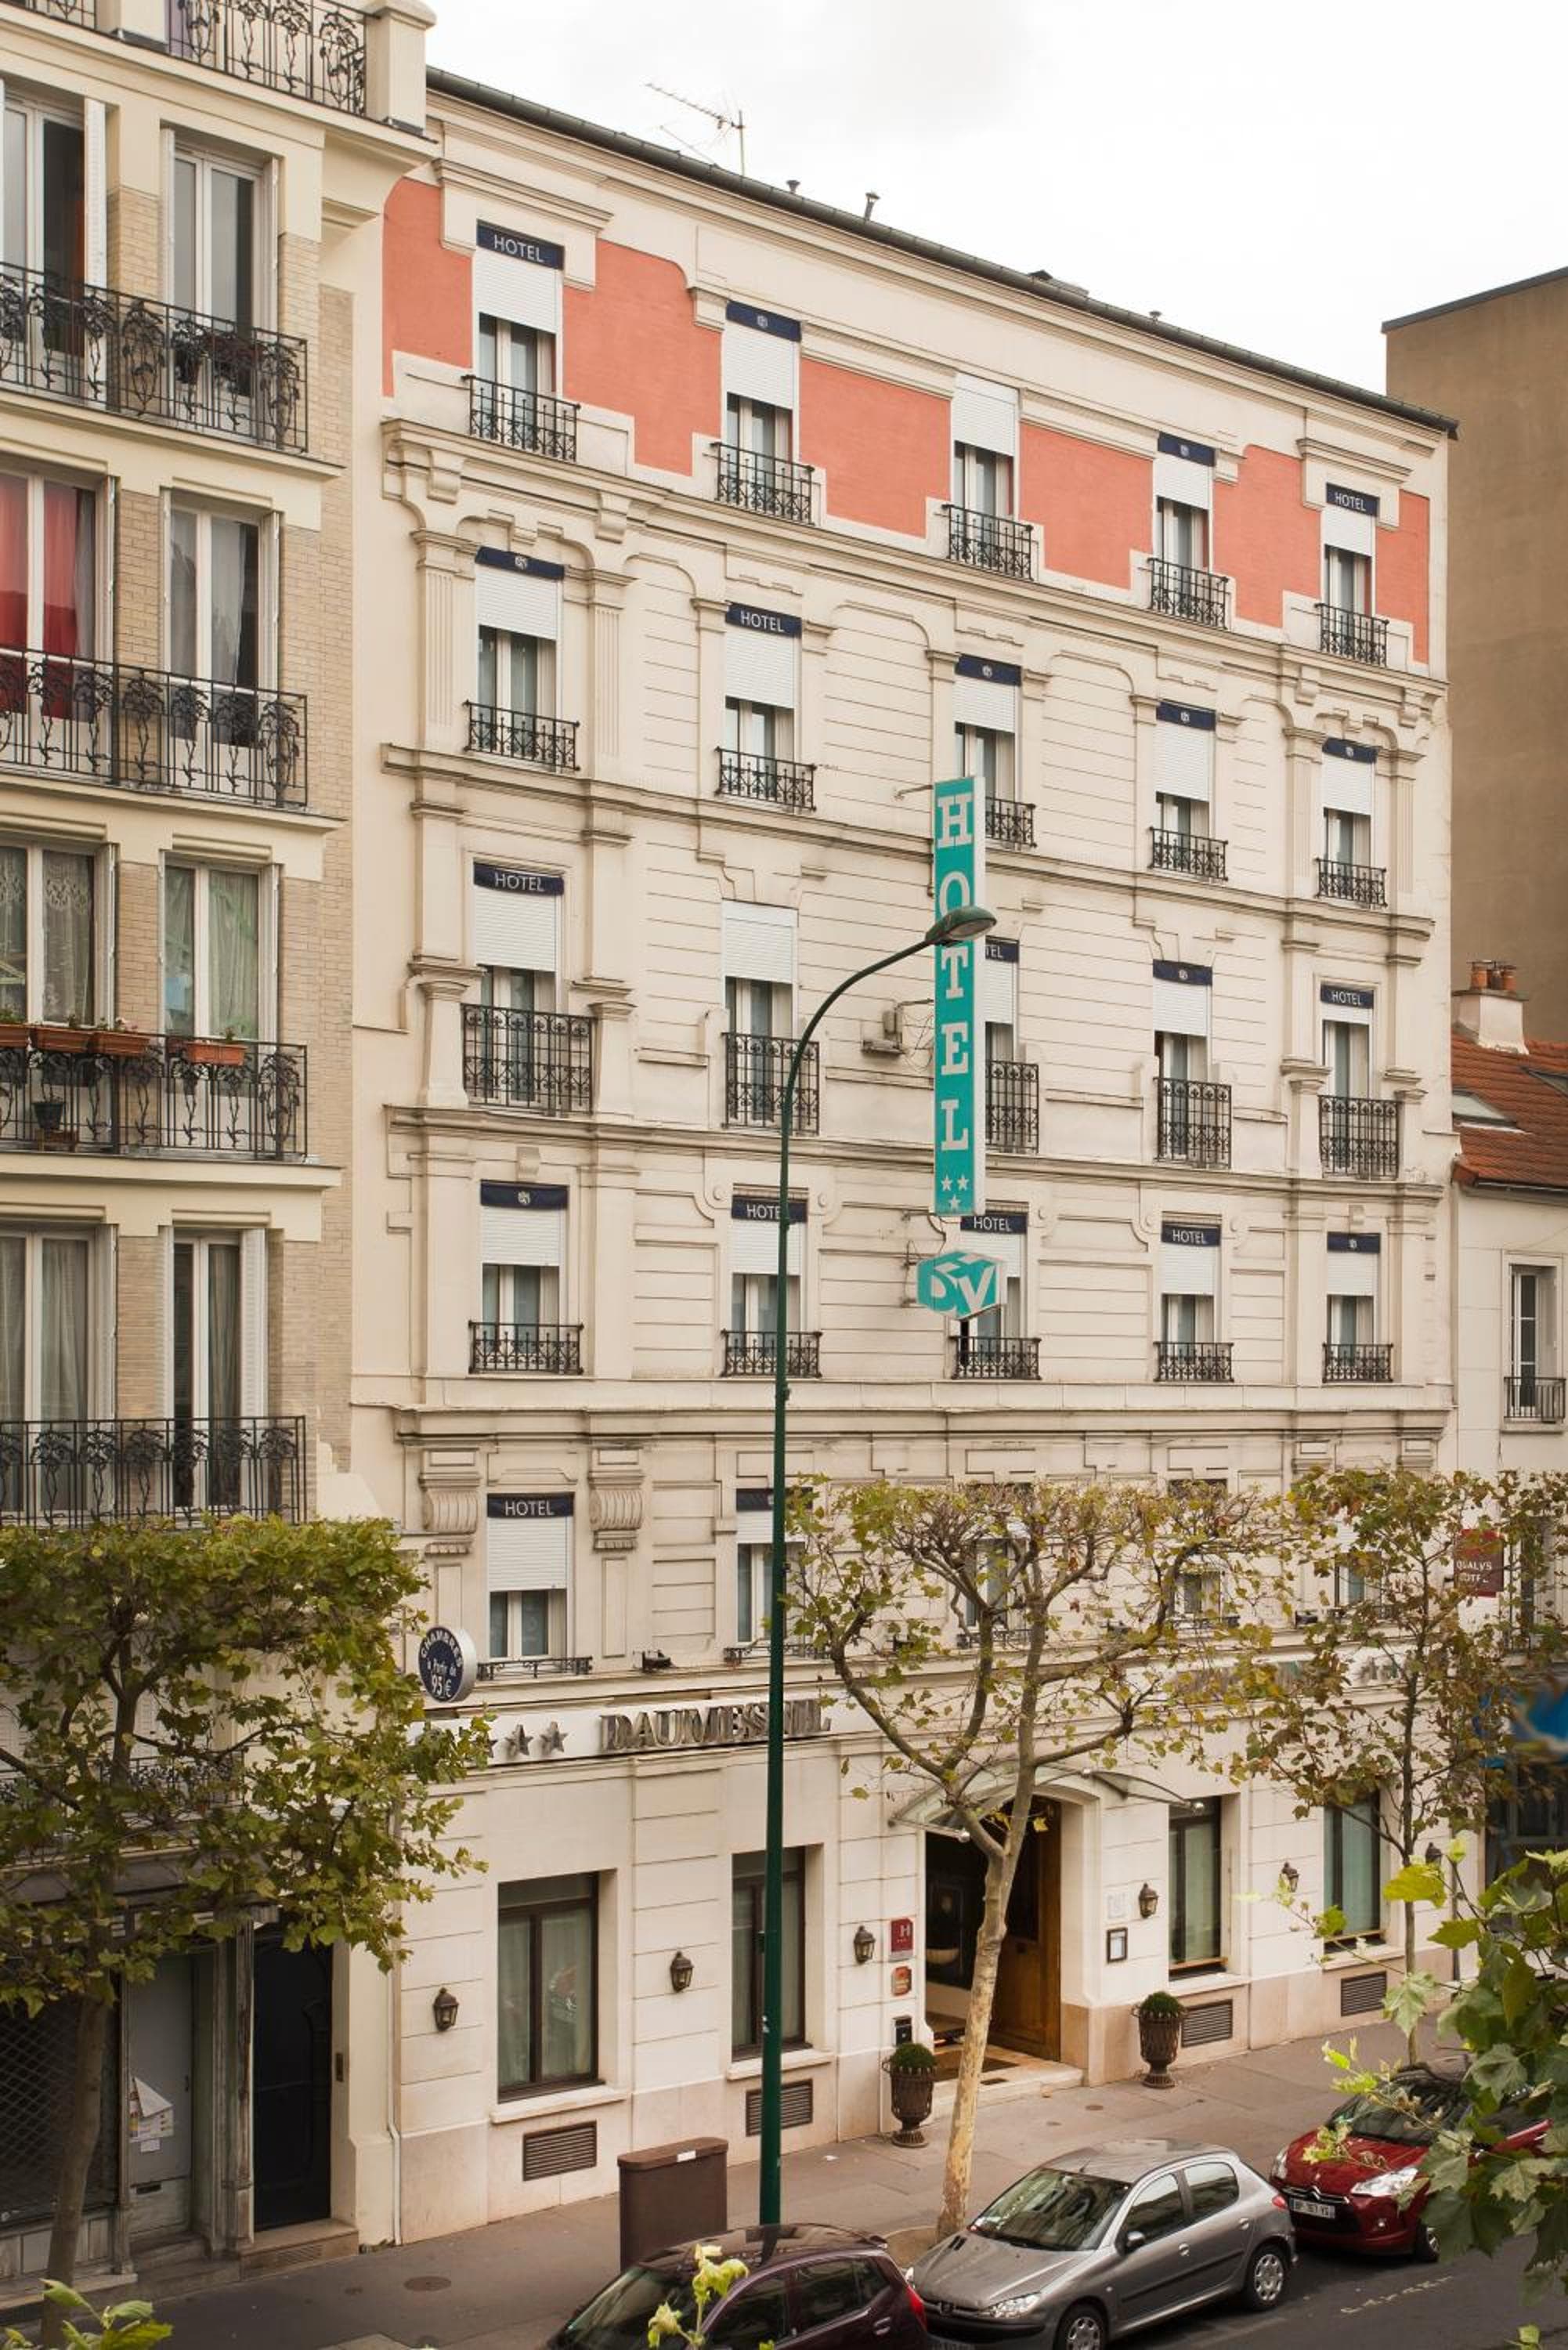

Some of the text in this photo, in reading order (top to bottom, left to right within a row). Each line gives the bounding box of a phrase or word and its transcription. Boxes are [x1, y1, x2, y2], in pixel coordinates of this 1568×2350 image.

[494, 234, 544, 262] HOTEL
[1335, 492, 1366, 512] HOTEL
[740, 610, 785, 632] HOTEL
[494, 871, 544, 892] HOTEL
[938, 791, 973, 1152] HOTEL
[1331, 990, 1362, 1005] HOTEL
[746, 1204, 781, 1219] HOTE
[974, 1216, 1013, 1232] HOTEL
[1172, 1229, 1208, 1245] HOTEL
[504, 1500, 555, 1517] HOTEL
